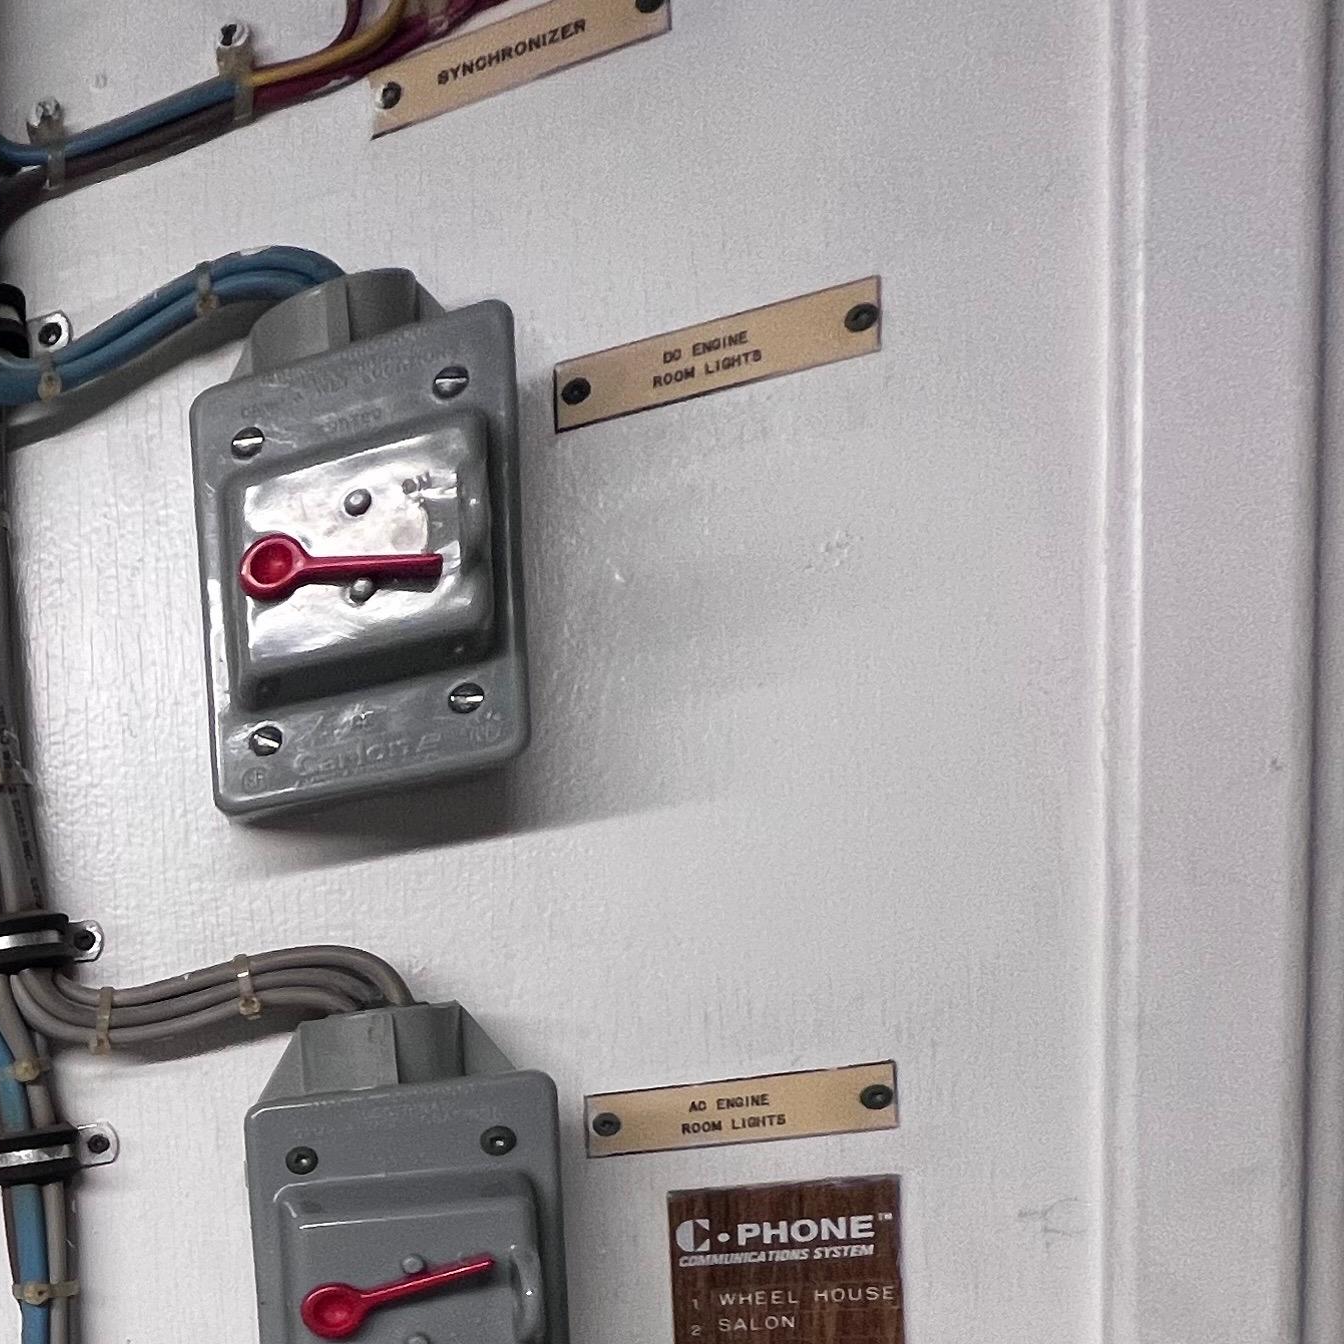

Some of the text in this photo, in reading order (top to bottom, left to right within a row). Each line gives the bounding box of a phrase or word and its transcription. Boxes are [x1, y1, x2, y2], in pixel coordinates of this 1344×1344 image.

[437, 18, 586, 85] SYNCHRONIZER
[692, 330, 749, 357] ENGINE
[652, 349, 762, 388] ROOM LIGHTS
[716, 1093, 770, 1110] ENGINE
[681, 1114, 786, 1135] ROOM LIGHTS
[679, 1244, 875, 1268] COMMUNICATIONS SYSTEM
[691, 1285, 895, 1310] 1 WHEEL HOUSE
[691, 1315, 796, 1336] 2 SALON
